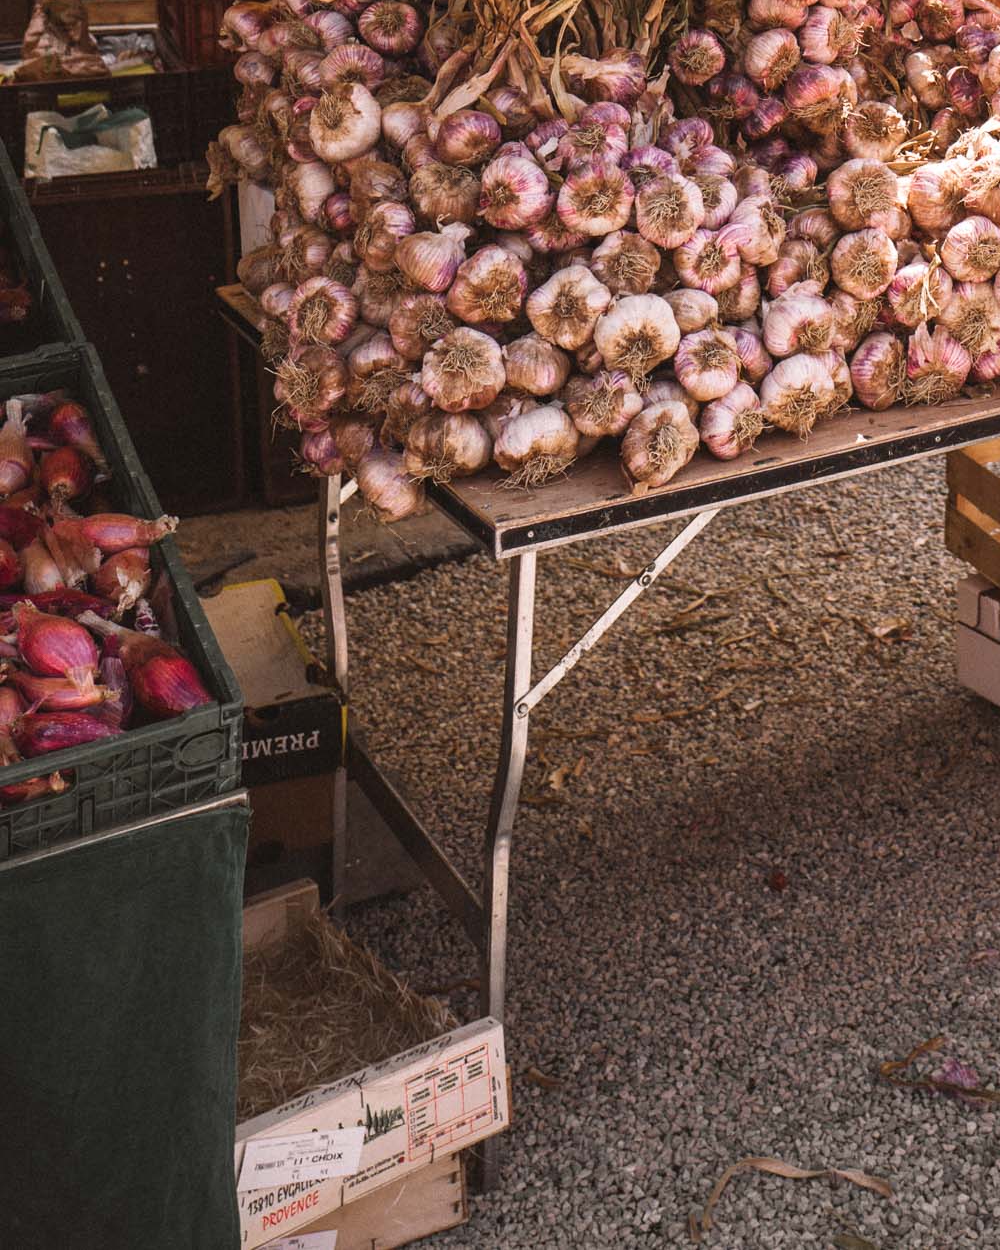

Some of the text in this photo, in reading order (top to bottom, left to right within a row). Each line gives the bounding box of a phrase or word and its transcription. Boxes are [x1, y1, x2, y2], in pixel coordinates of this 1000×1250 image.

[311, 1152, 343, 1163] CHOIX
[248, 1177, 327, 1216] 13810 EYGALIE
[262, 1190, 320, 1231] PROVENCE
